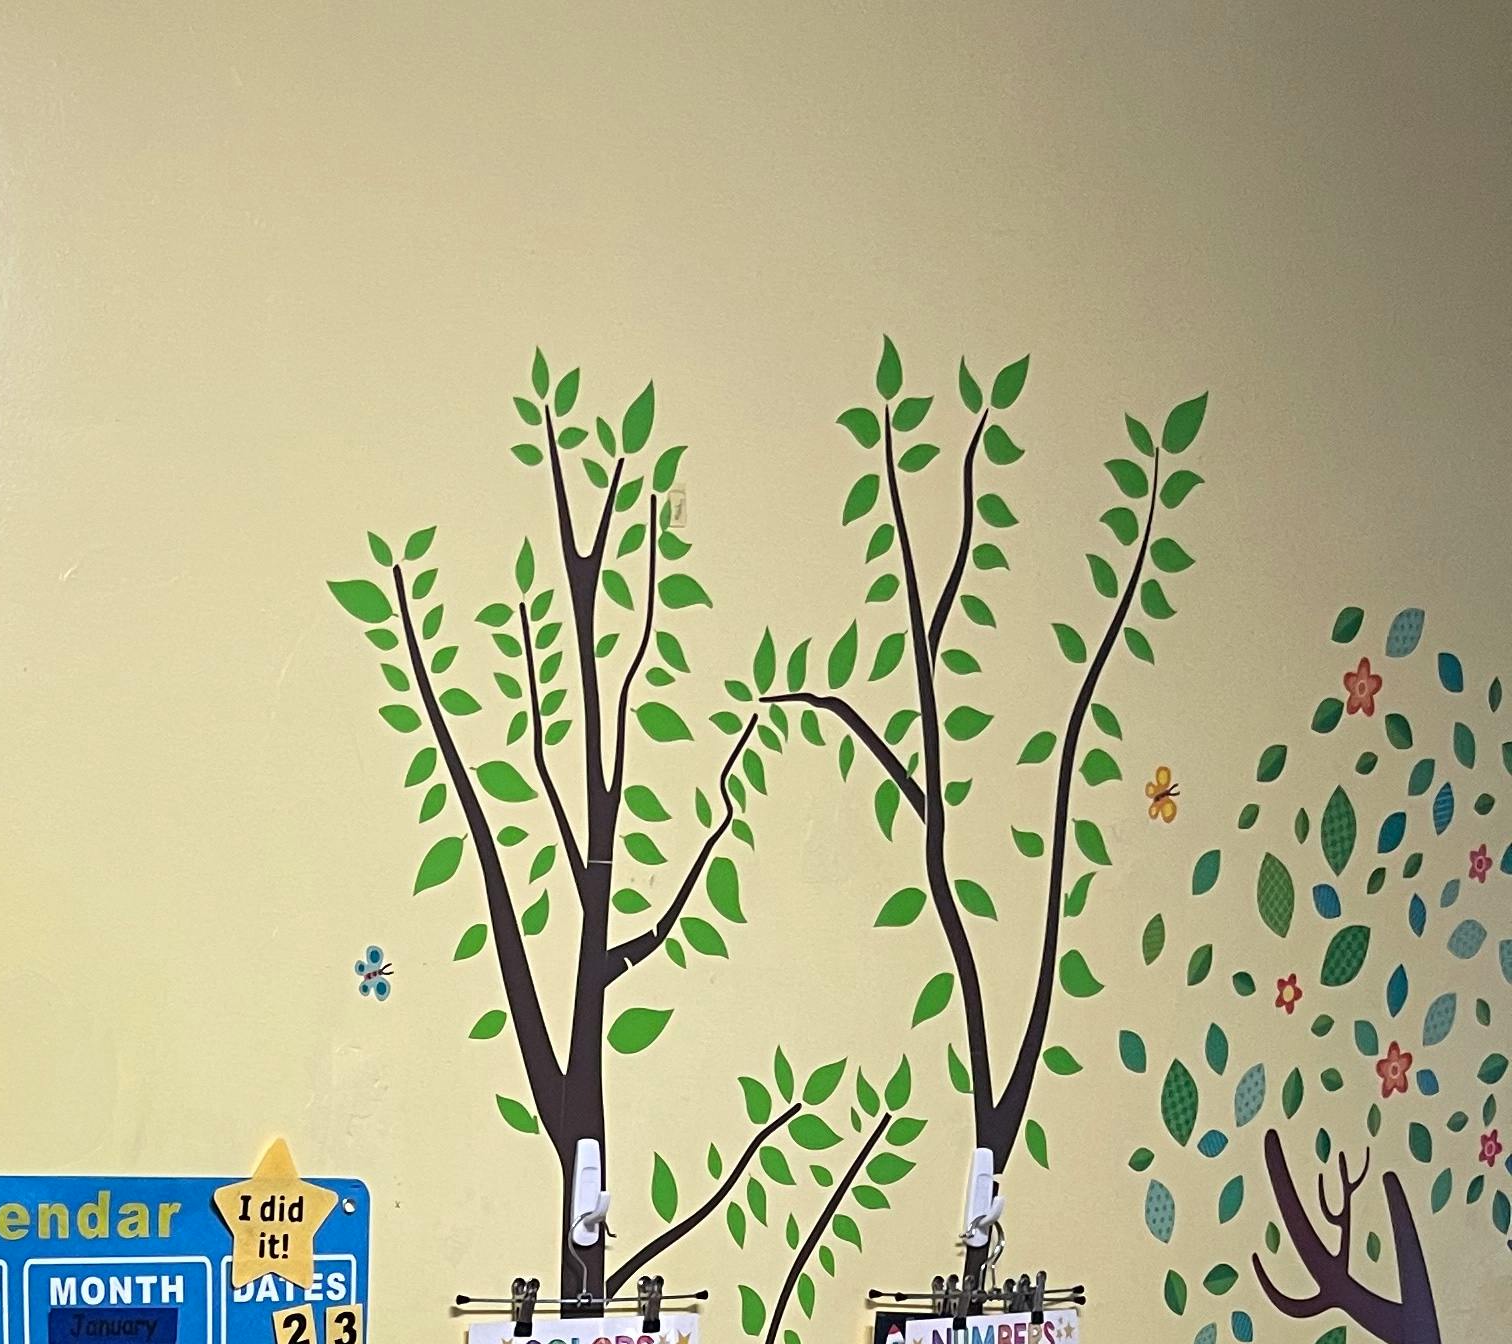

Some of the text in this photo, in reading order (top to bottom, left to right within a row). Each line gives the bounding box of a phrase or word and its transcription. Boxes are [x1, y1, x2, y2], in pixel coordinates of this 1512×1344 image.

[238, 1195, 304, 1223] I did
[258, 1232, 289, 1258] it!
[49, 1275, 184, 1305] MONTH
[70, 1313, 158, 1340] January
